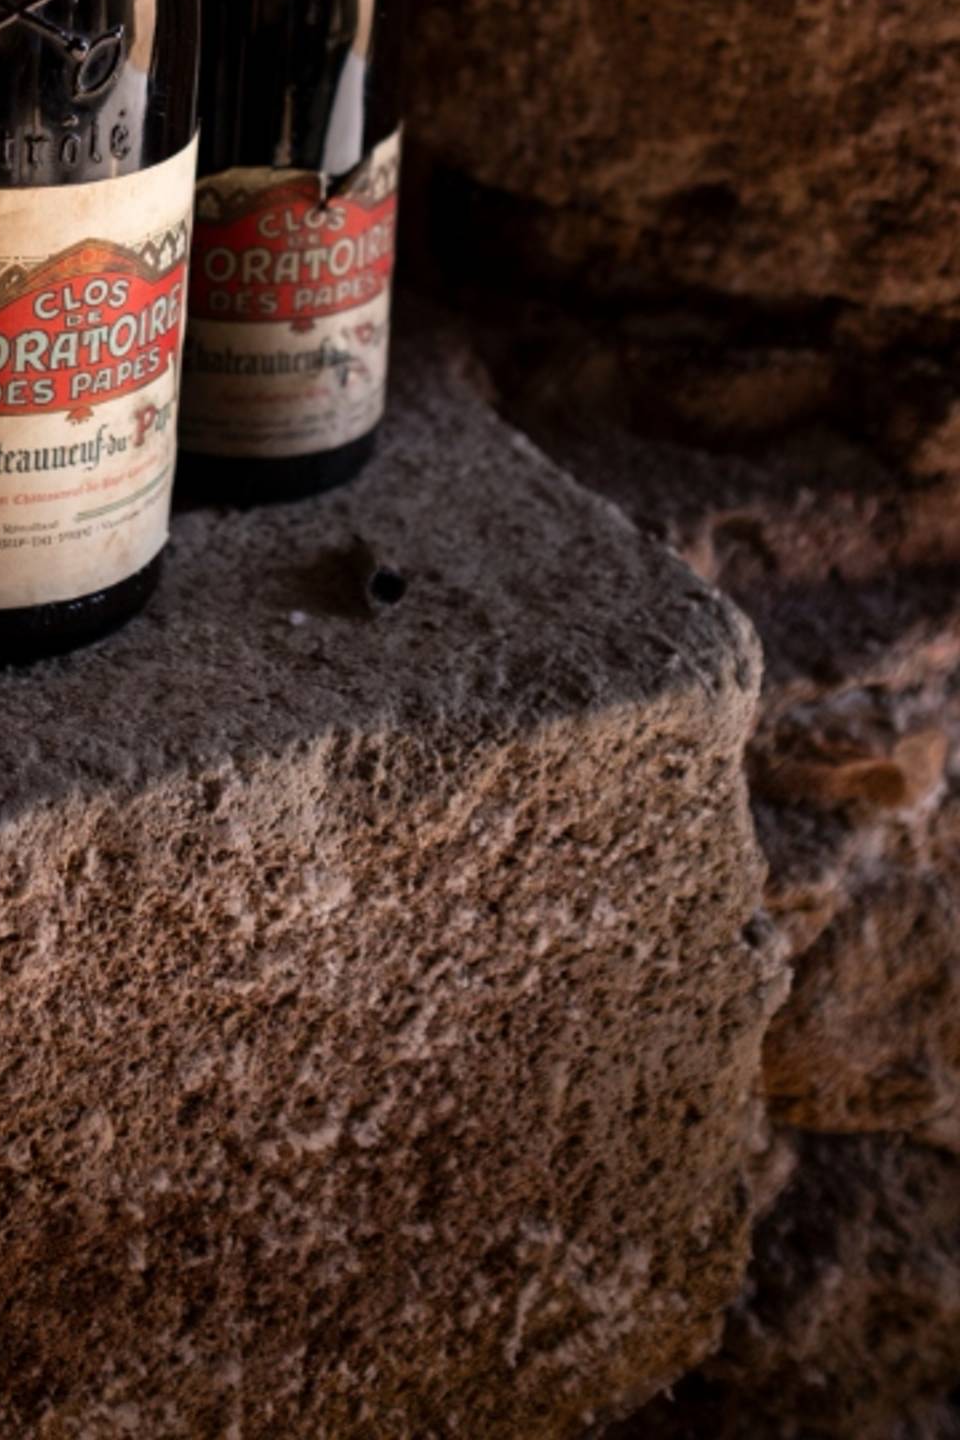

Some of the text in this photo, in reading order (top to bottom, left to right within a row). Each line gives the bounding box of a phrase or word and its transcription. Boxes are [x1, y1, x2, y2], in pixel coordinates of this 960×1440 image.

[258, 206, 346, 239] CLOS
[203, 215, 392, 285] ORATOIRE
[34, 279, 129, 319] CLOS
[208, 272, 376, 315] DES PAPES
[67, 310, 103, 328] DE
[71, 346, 159, 400] PAPES
